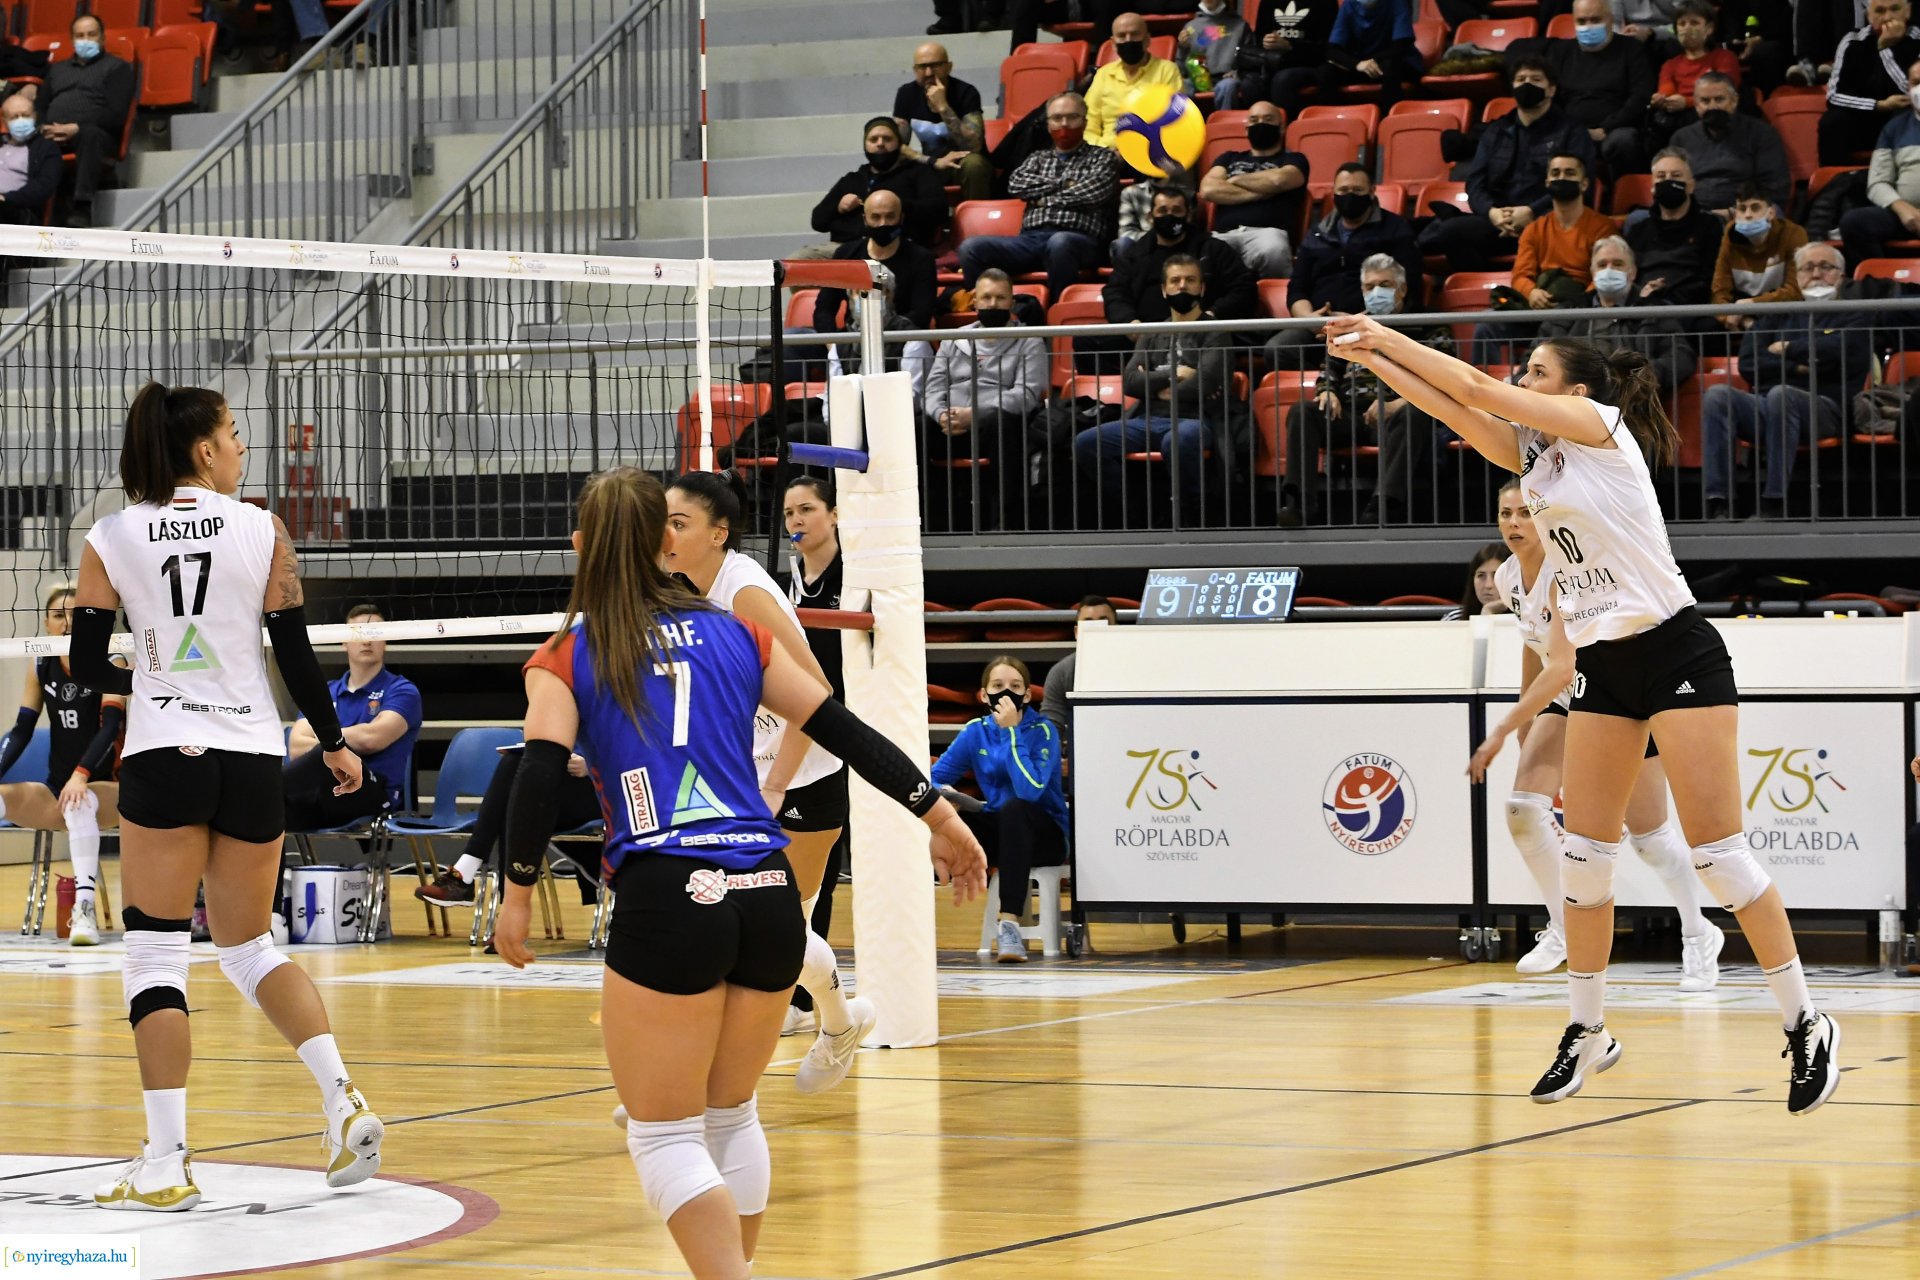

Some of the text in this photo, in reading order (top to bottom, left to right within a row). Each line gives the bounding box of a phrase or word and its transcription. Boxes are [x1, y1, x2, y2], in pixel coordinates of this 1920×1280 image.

[131, 238, 163, 255] FATUM
[149, 517, 225, 542] LÁSZLOP
[1549, 526, 1584, 564] 10
[161, 551, 212, 617] 17
[1246, 572, 1297, 584] FATUM
[1156, 586, 1180, 617] 9
[1252, 584, 1277, 616] 8
[24, 640, 52, 653] FATUM
[182, 702, 251, 715] BESTRONG
[653, 661, 691, 747] 7
[58, 709, 79, 729] 18
[1345, 755, 1392, 771] FATUM
[629, 772, 650, 831] STRABAG
[1151, 815, 1191, 824] MAGYAR
[1774, 817, 1818, 826] MAGYAR
[680, 833, 771, 847] BESTRONG
[1115, 824, 1230, 847] RÖPLABDA
[1744, 827, 1859, 851] ÖPLABDA
[1146, 851, 1198, 862] SZÖVETSÉG
[1768, 855, 1825, 866] SZÖVETSÉG
